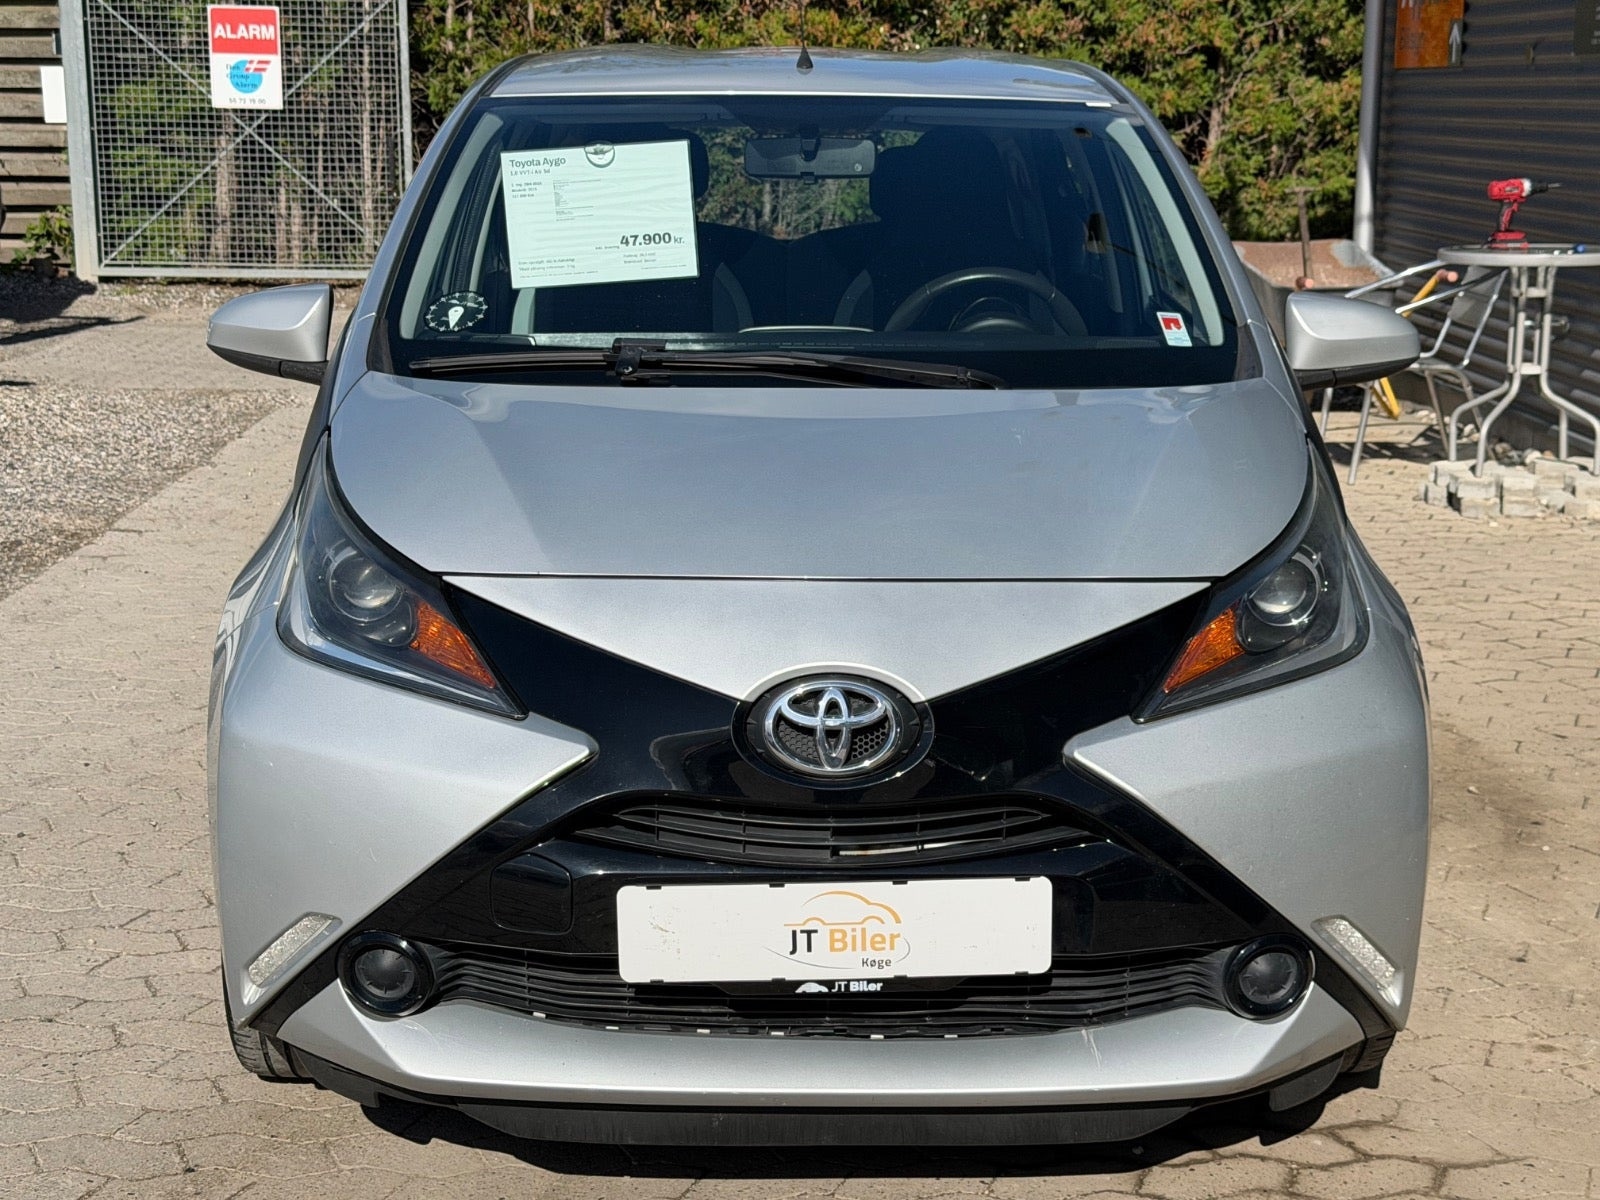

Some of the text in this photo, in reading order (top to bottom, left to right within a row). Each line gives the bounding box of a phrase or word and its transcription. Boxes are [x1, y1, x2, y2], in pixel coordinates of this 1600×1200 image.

[214, 23, 275, 41] ALARM
[509, 156, 567, 169] Toyota Aygo
[620, 232, 685, 247] 47.900 kr.
[789, 927, 901, 956] JT Biler
[861, 957, 892, 970] Køge
[831, 980, 883, 993] JT Biler
